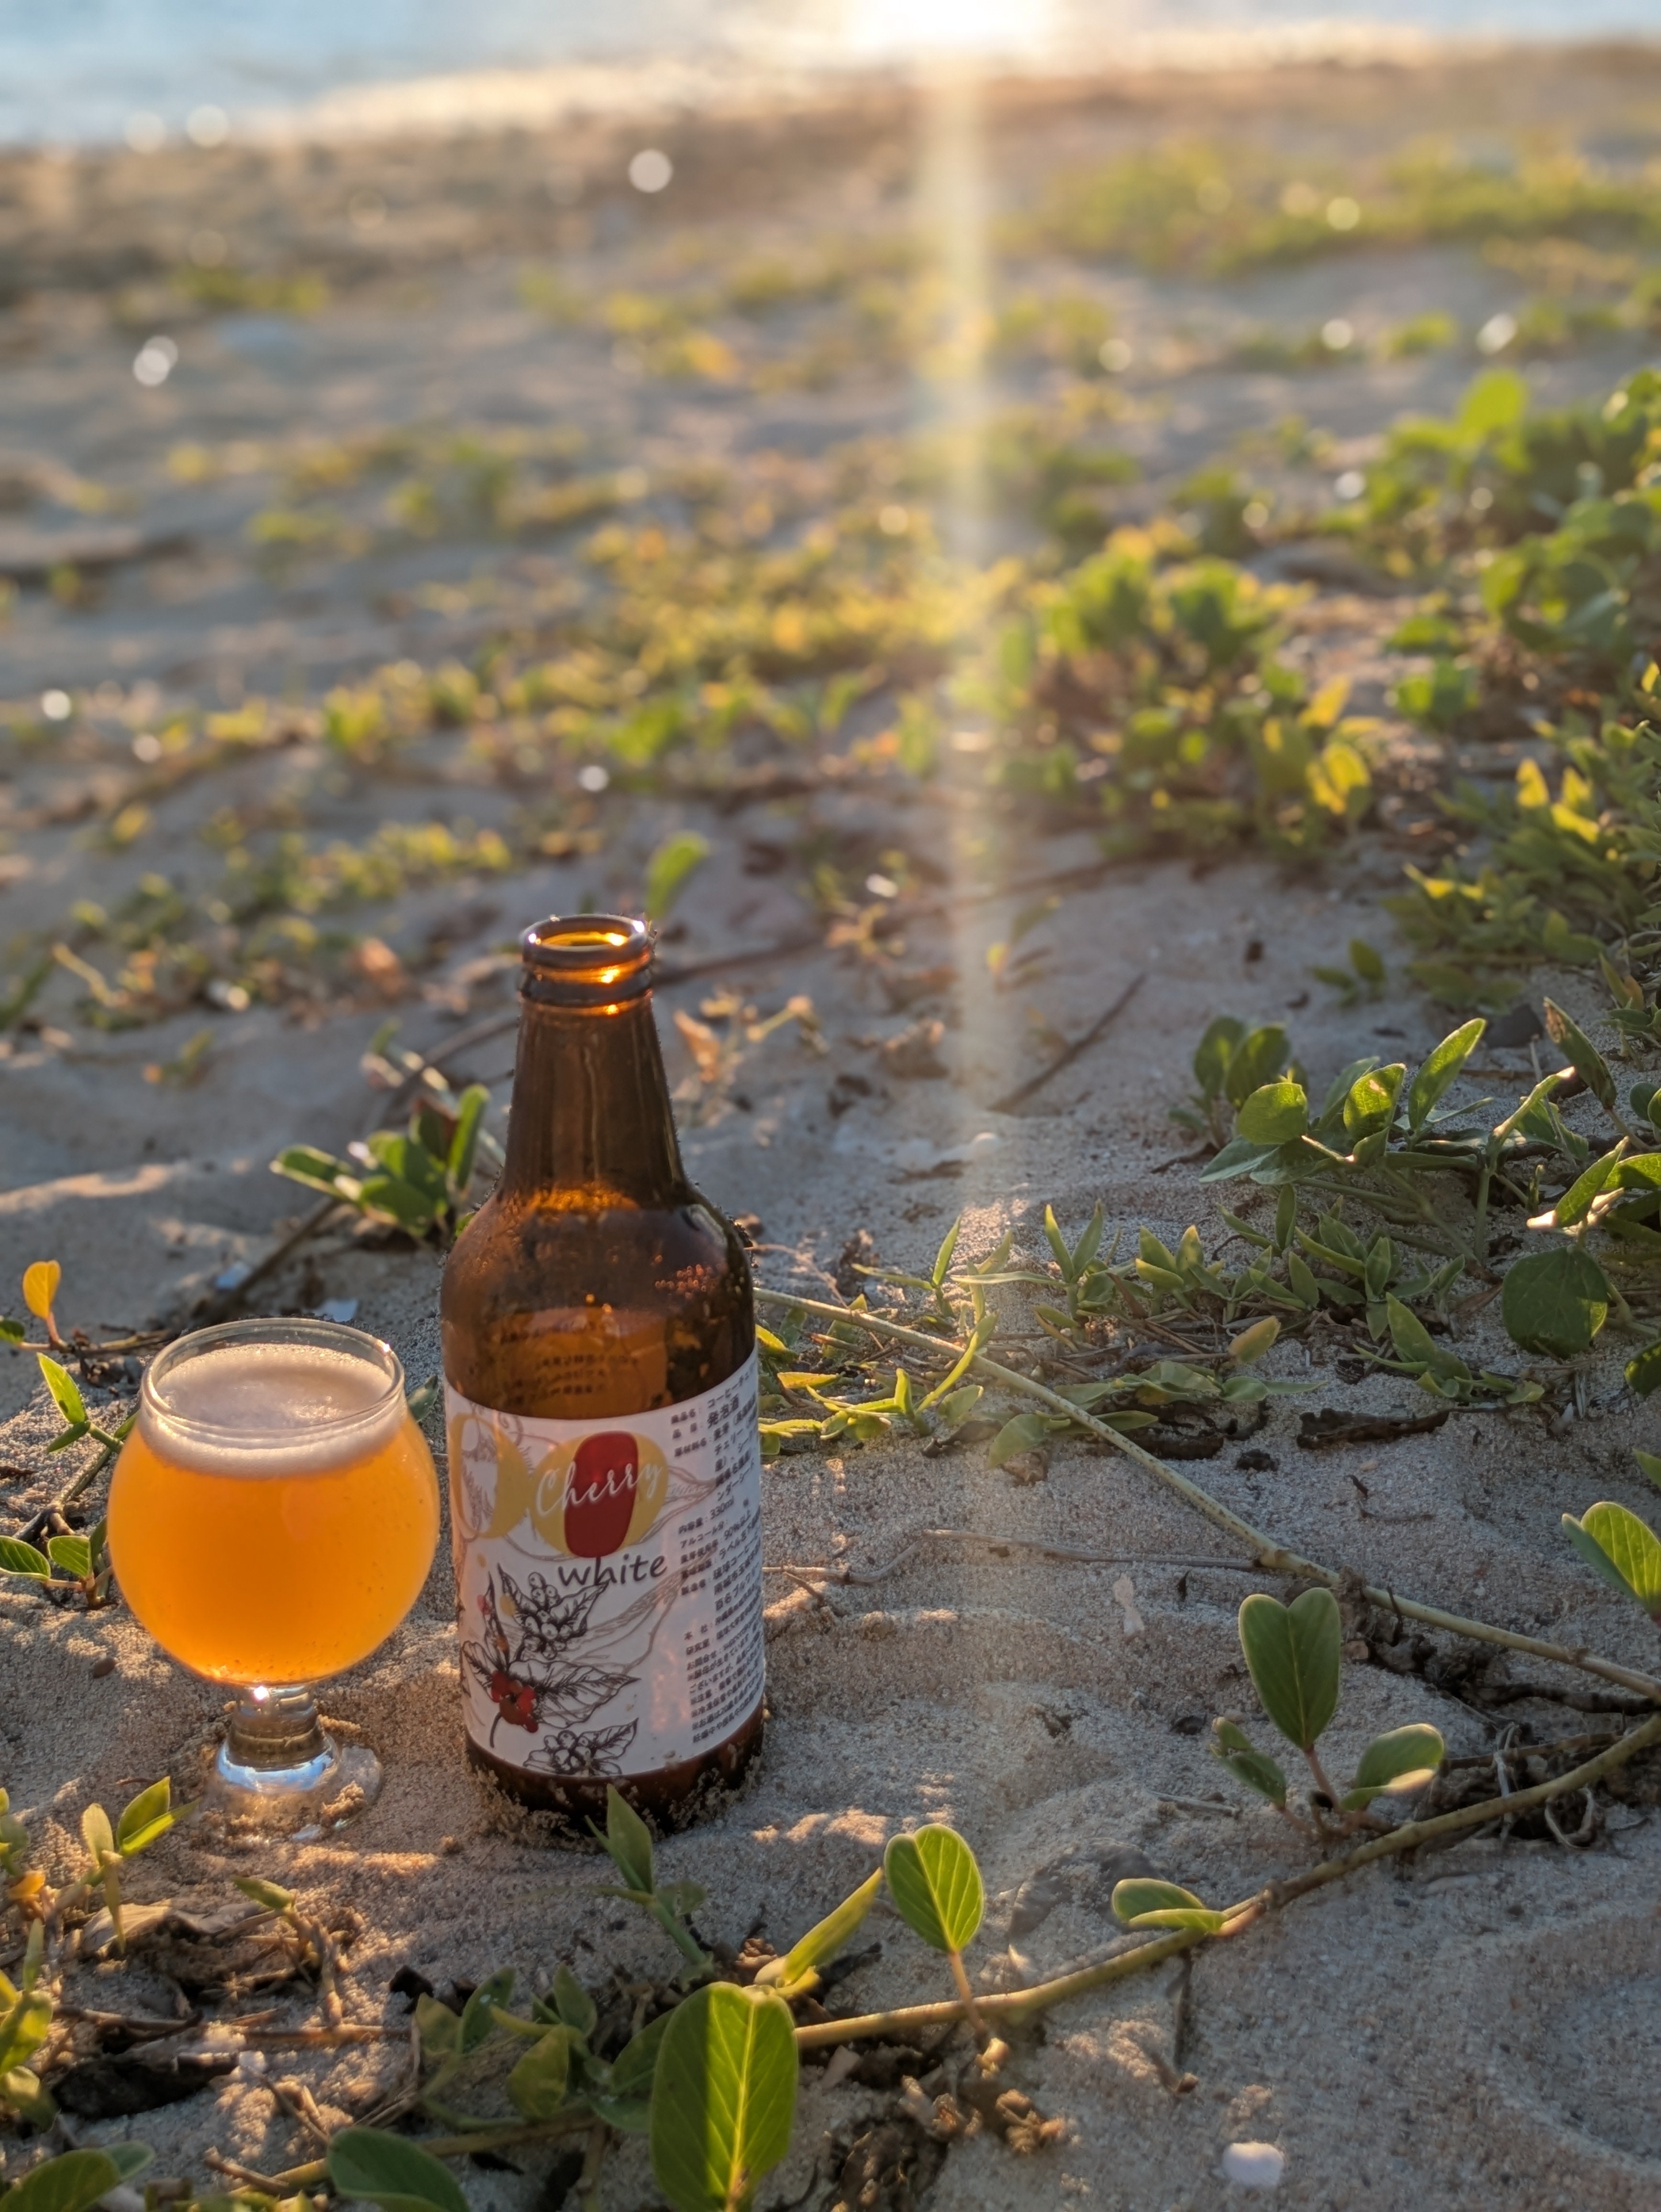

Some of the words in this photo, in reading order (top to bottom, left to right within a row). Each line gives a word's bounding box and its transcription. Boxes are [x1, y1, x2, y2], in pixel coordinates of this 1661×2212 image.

[707, 1393, 739, 1429] 発泡酒
[537, 1460, 662, 1517] Cherry
[558, 1554, 666, 1586] white
